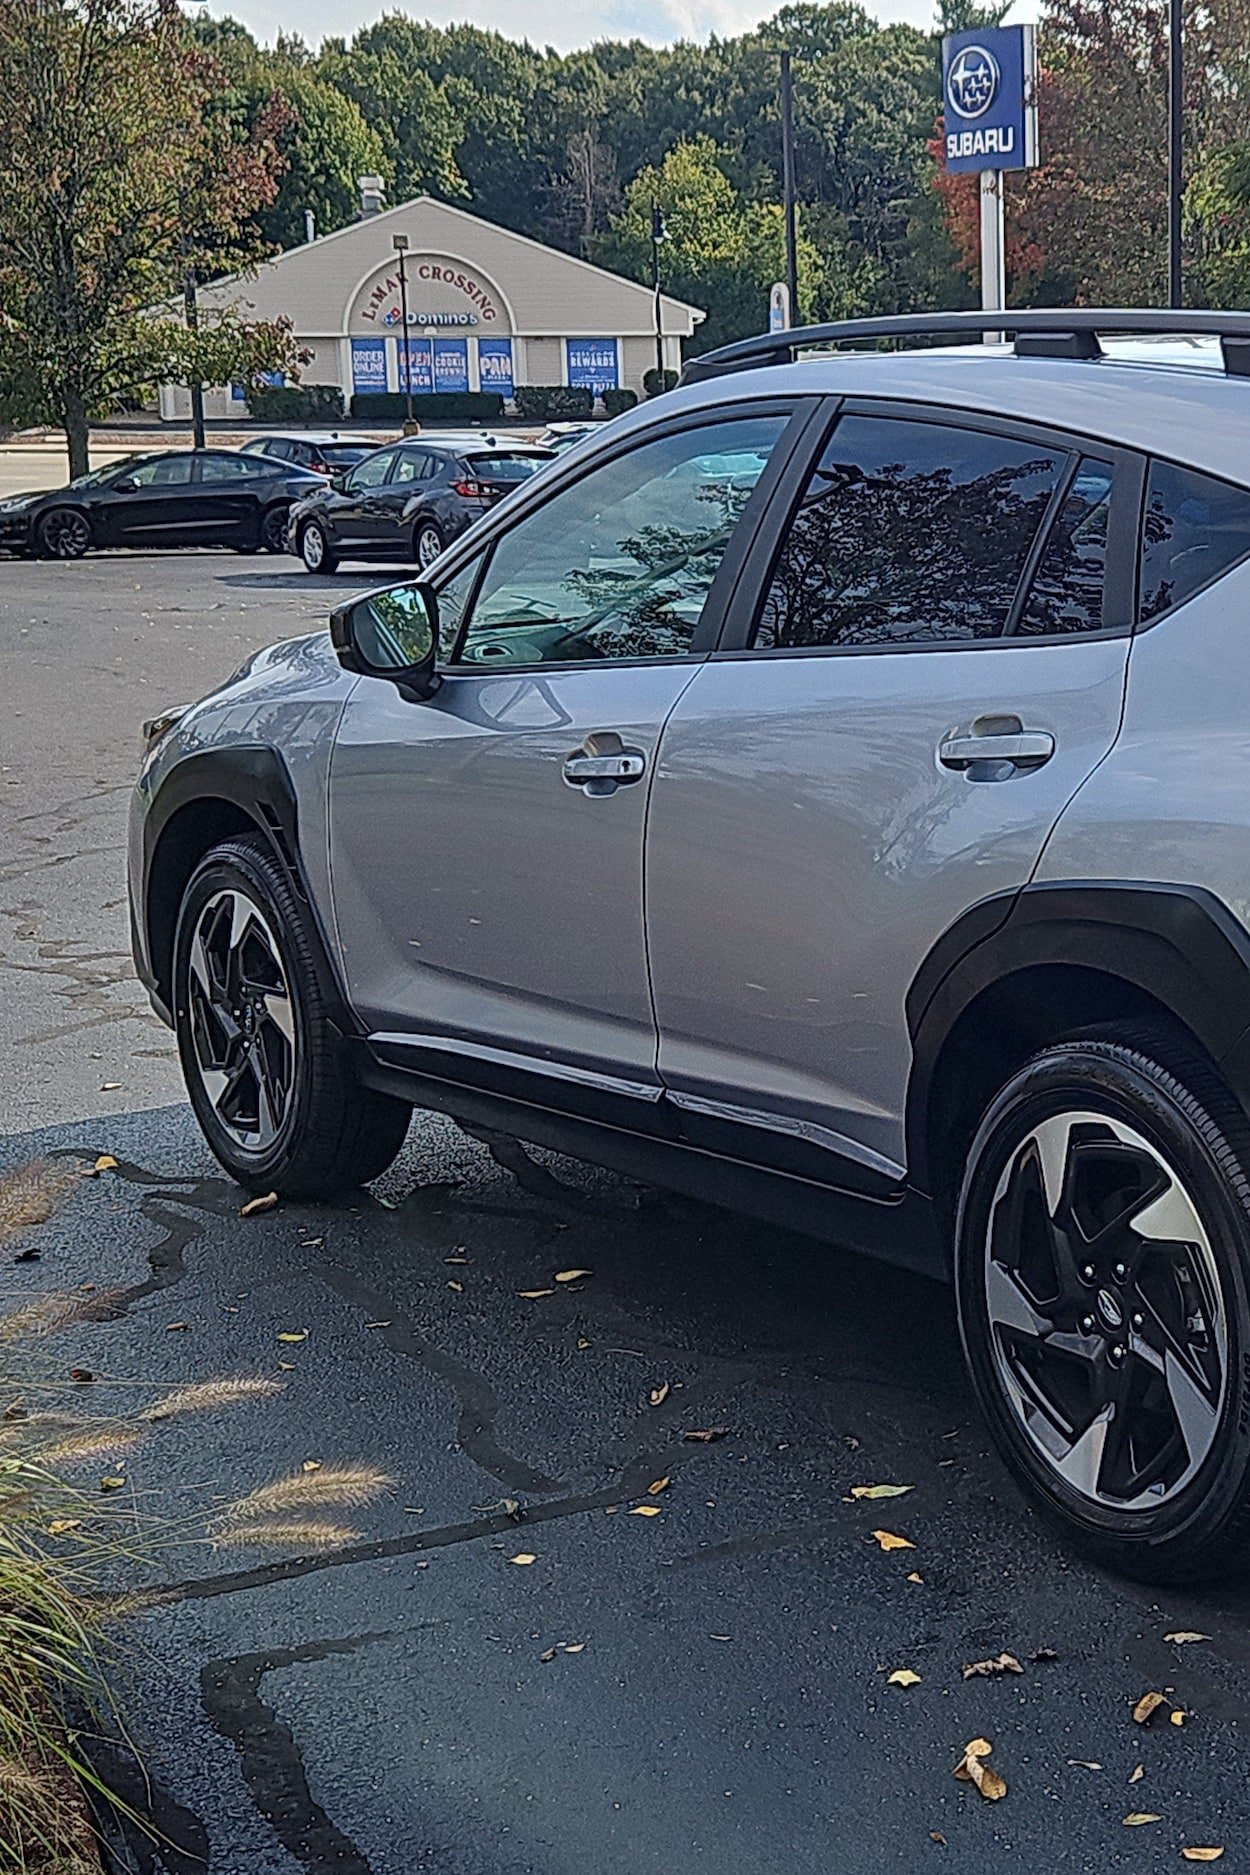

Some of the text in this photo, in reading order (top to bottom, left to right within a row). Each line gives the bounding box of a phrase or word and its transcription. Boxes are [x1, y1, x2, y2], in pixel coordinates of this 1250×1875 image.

[947, 126, 1014, 158] SUBARU
[418, 265, 497, 321] CROSSING
[406, 311, 478, 325] Domino's
[353, 350, 384, 361] ORDER
[570, 356, 615, 367] REWARDS
[353, 361, 385, 373] ONLINE
[480, 356, 511, 376] PAN
